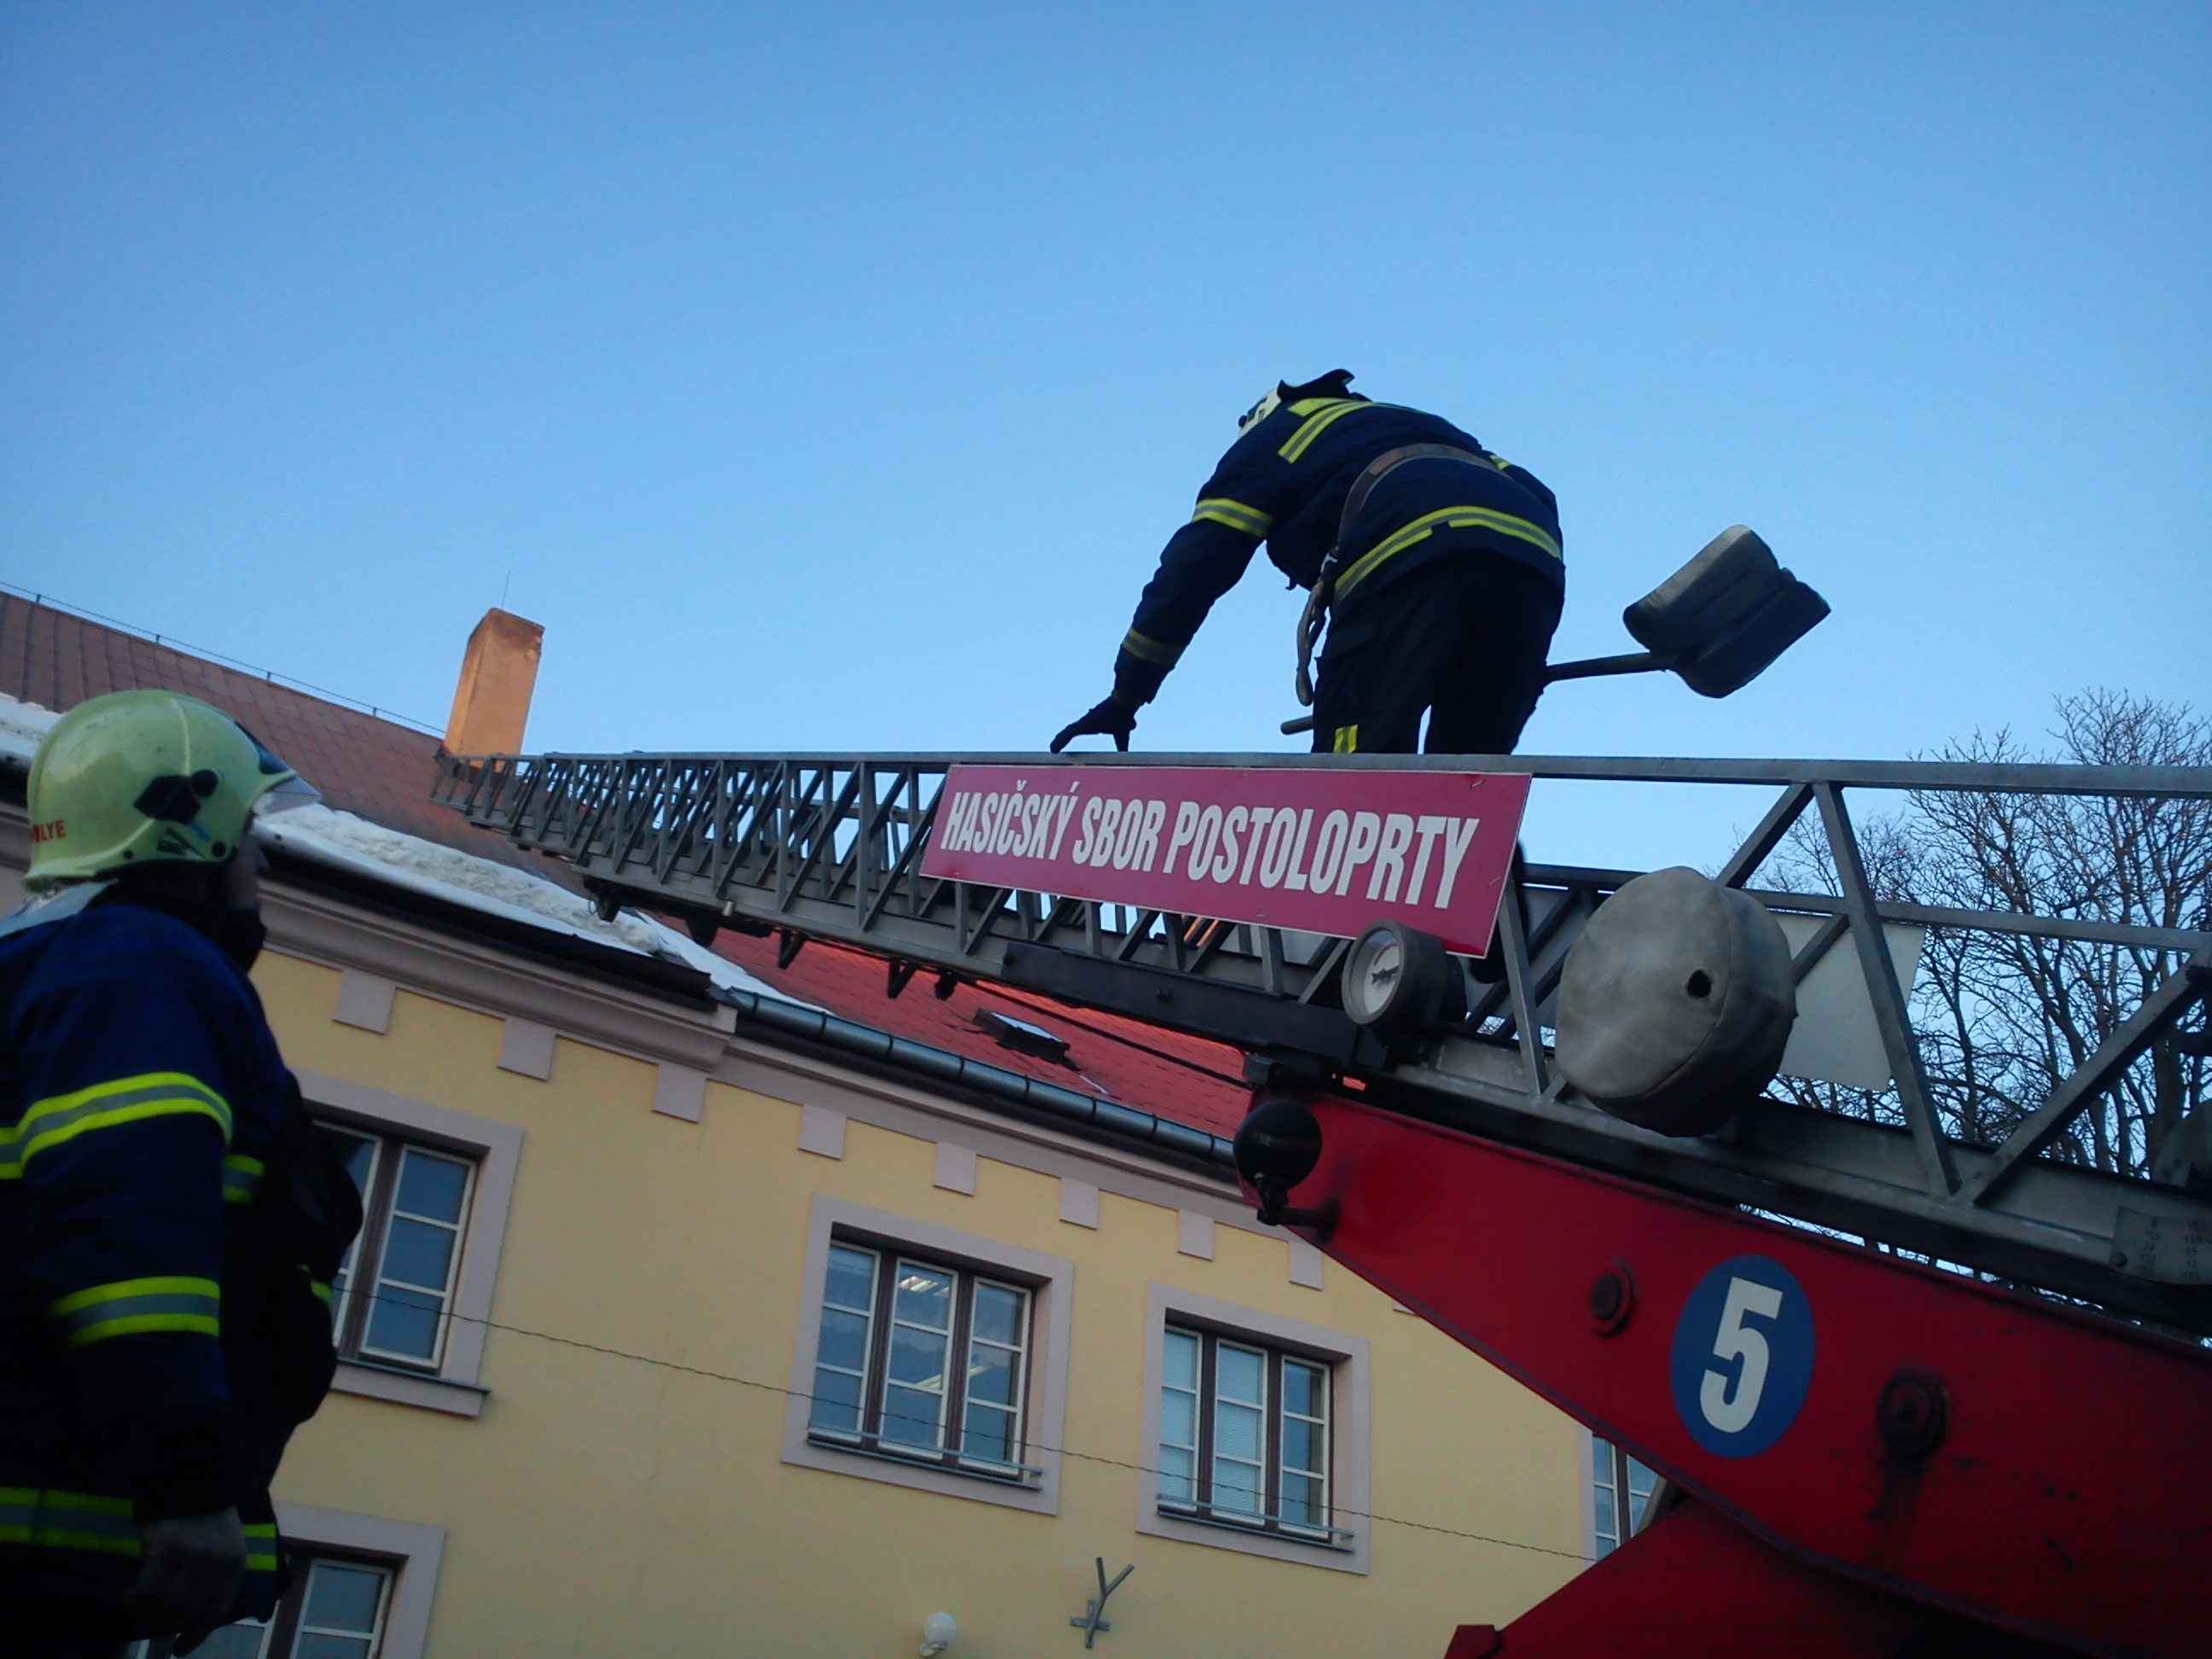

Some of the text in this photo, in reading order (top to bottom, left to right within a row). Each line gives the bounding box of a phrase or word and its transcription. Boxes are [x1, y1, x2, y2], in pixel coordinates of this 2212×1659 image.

[940, 779, 1480, 909] HASIČSKÝ SBOR POSTOLOPRTY
[1700, 1277, 1784, 1434] 5
